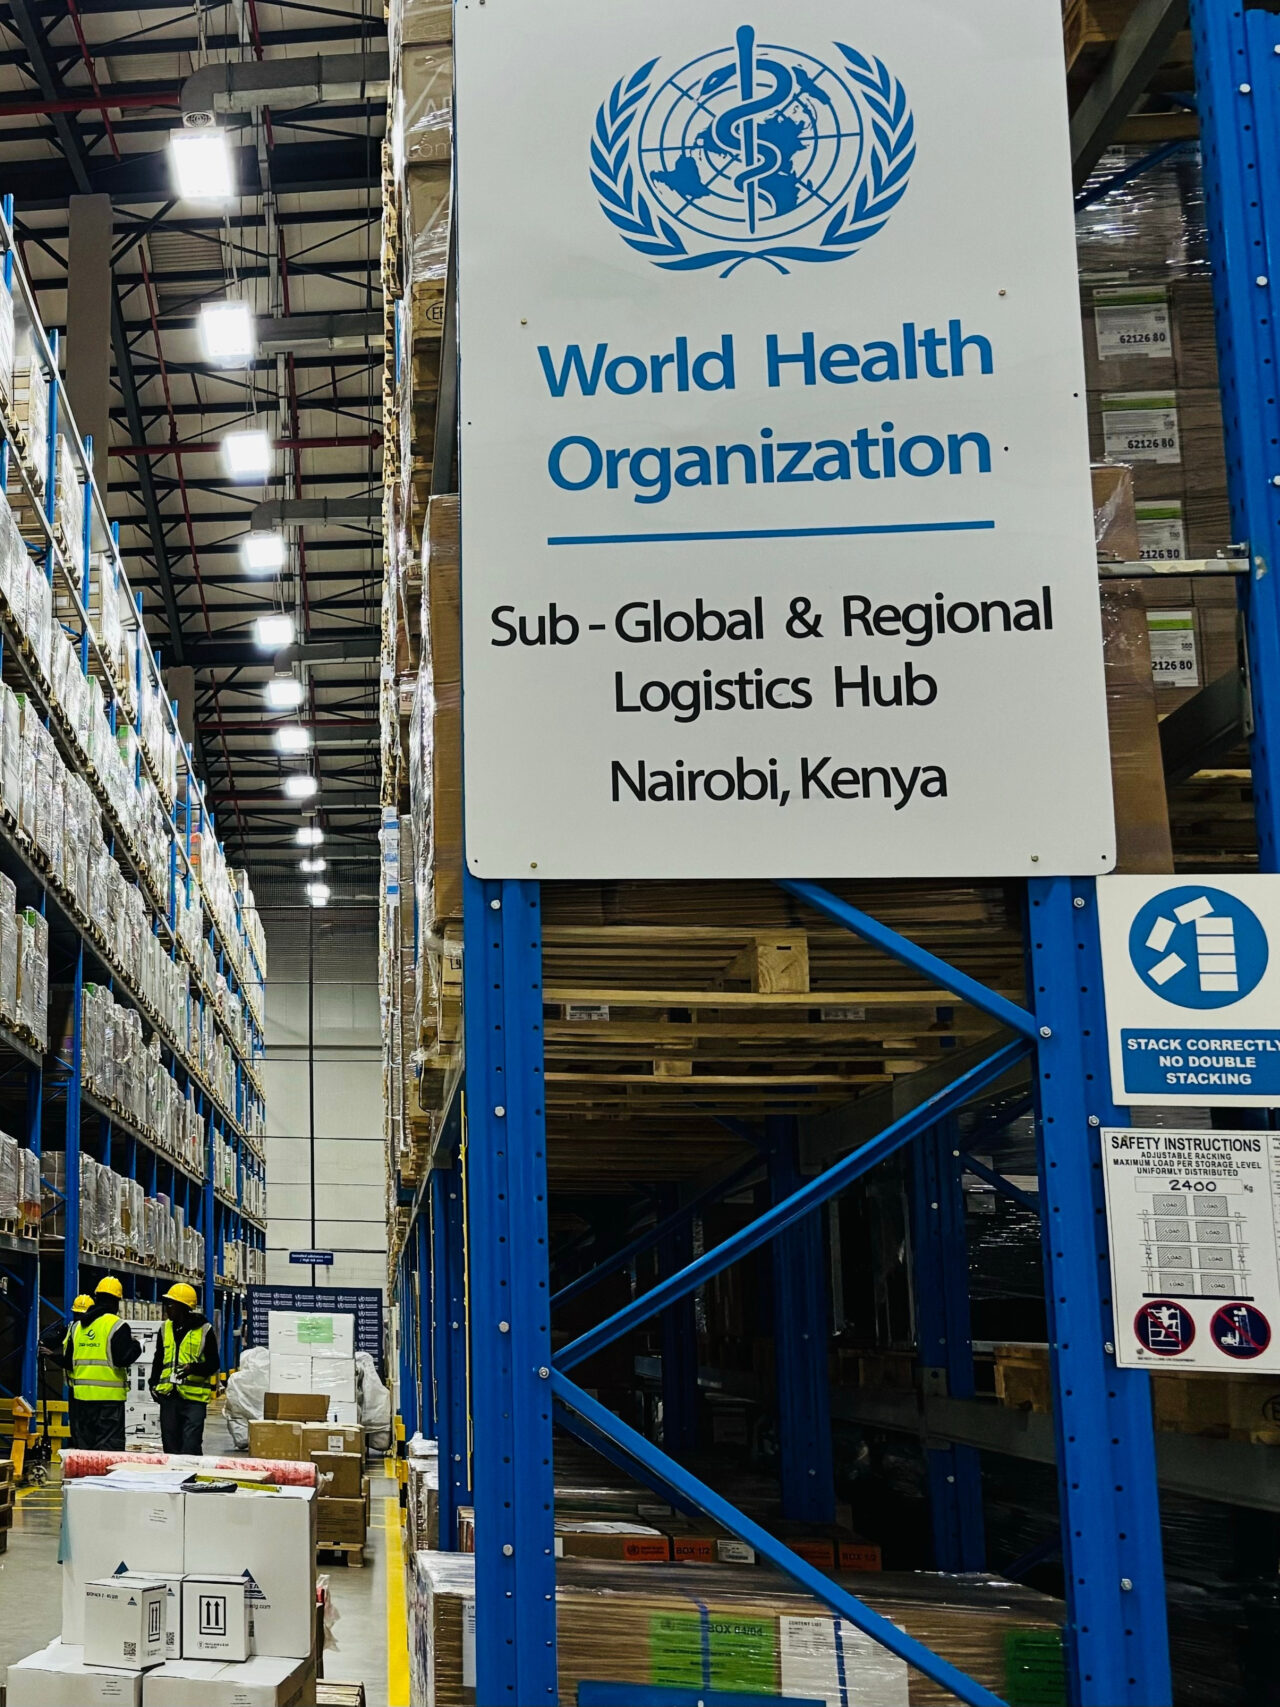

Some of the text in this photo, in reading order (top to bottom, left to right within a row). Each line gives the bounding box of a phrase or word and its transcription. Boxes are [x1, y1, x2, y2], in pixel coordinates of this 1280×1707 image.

[1120, 332, 1166, 345] 62126 80
[536, 319, 994, 398] World Health
[1127, 437, 1175, 450] 62126 80
[547, 421, 992, 505] Organization
[1139, 549, 1180, 560] 2126 80
[785, 596, 825, 639] &
[842, 585, 1053, 647] Regional
[1151, 659, 1193, 671] 2126 80
[615, 661, 938, 724] Logistics Hub
[611, 756, 948, 811] Nairobi, Kenya
[1127, 1038, 1280, 1052] STACK CORRECTLY
[1159, 1055, 1257, 1068] NO DOUBLE
[1166, 1072, 1252, 1085] STACKING
[1111, 1136, 1262, 1152] SAFETY INSTRUCTIONS
[1141, 1152, 1232, 1161] ADJUSTABLE RACKING
[1113, 1158, 1262, 1169] MAXIMUM LOAD PER STORAGE LEVEL
[1137, 1167, 1239, 1177] UNIFORMLY DISTRIBUTED
[1168, 1179, 1217, 1192] 2400
[676, 1546, 695, 1555] BOX
[707, 1624, 732, 1634] BOX
